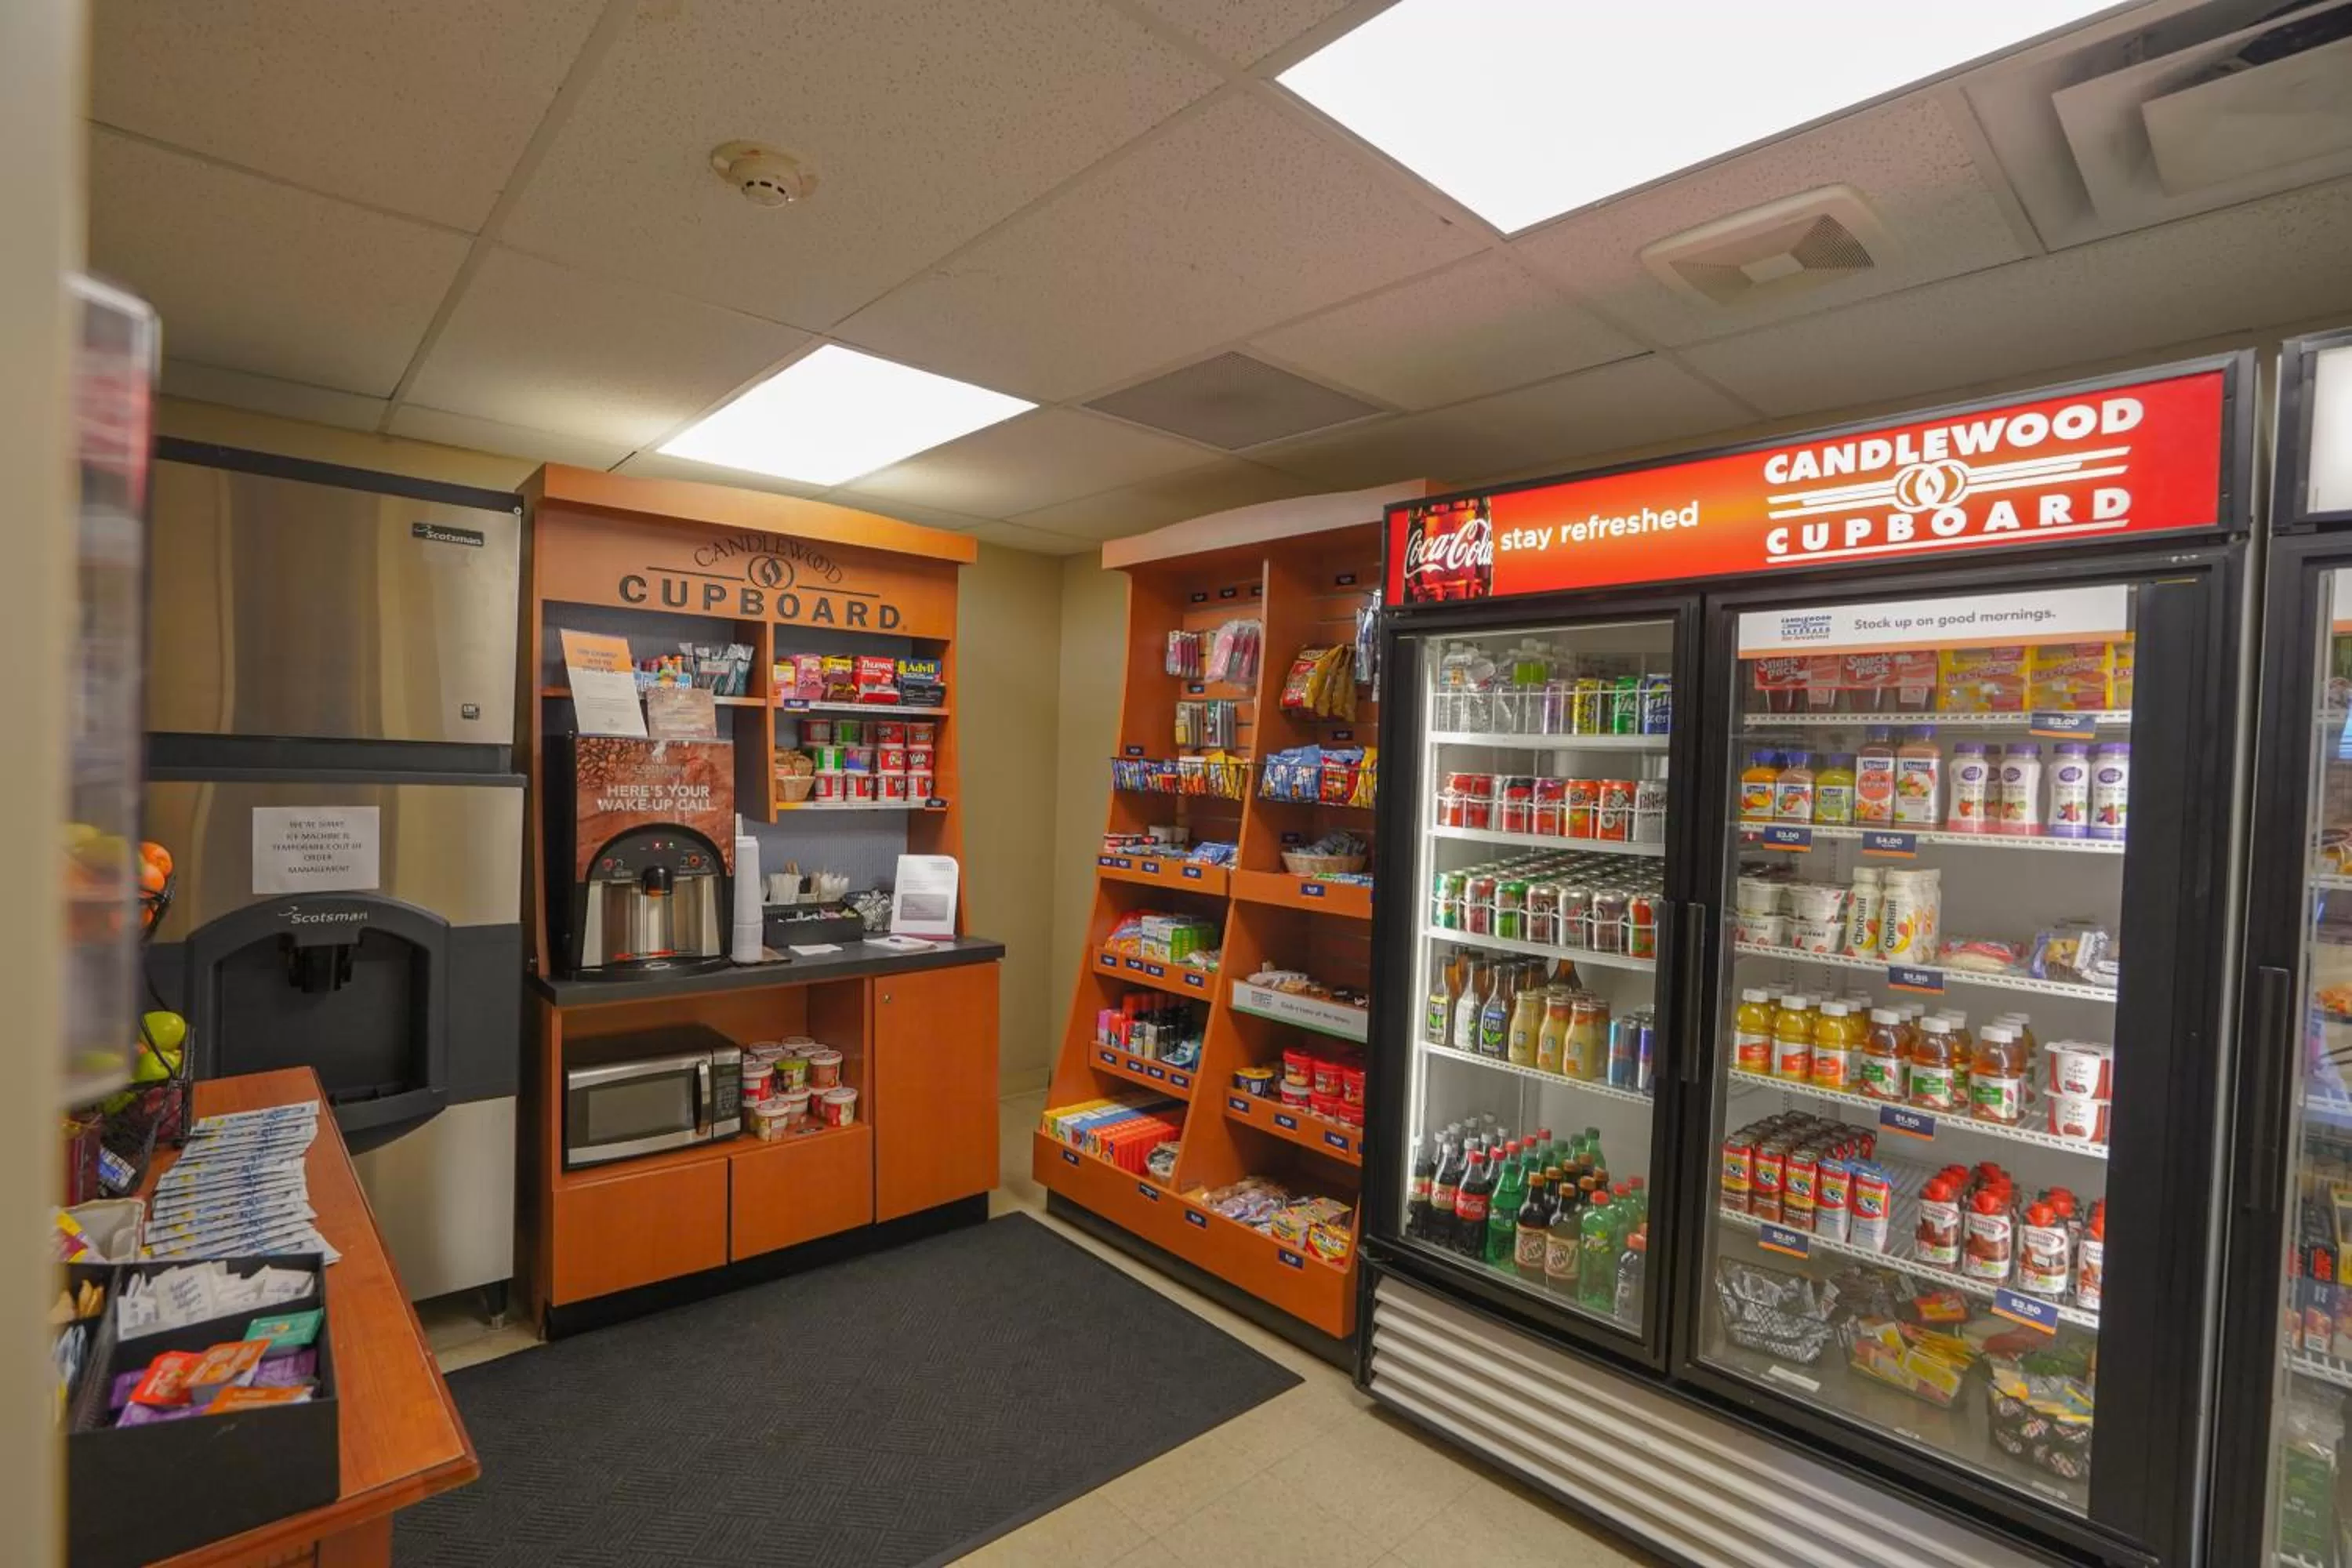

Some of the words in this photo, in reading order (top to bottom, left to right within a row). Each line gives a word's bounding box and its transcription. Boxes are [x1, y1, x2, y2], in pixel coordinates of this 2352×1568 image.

[1764, 397, 2144, 484] CANDLEWOOD
[1501, 526, 1552, 550] stay
[1561, 500, 1700, 543] refreshed
[1766, 487, 2132, 554] CUPBOARD
[694, 533, 844, 584] CANDLEWOOD
[1404, 517, 1494, 579] Coca-Cola
[619, 574, 901, 630] CUPBOARD
[1854, 617, 1891, 630] Stock
[1895, 619, 1913, 629] up
[1916, 618, 1934, 626] on
[1938, 612, 1976, 628] good
[1980, 608, 2056, 622] mornings.
[907, 662, 935, 673] Advil
[1767, 666, 1798, 680] pack
[1846, 654, 1889, 670] Snack
[1856, 666, 1889, 680] pack
[597, 798, 673, 811] WAKE-UP
[606, 785, 663, 797] HERE'S
[667, 784, 710, 797] YOUR
[291, 911, 368, 925] Scotsman
[1853, 897, 1867, 946] Chobani
[1885, 899, 1897, 949] Chobani
